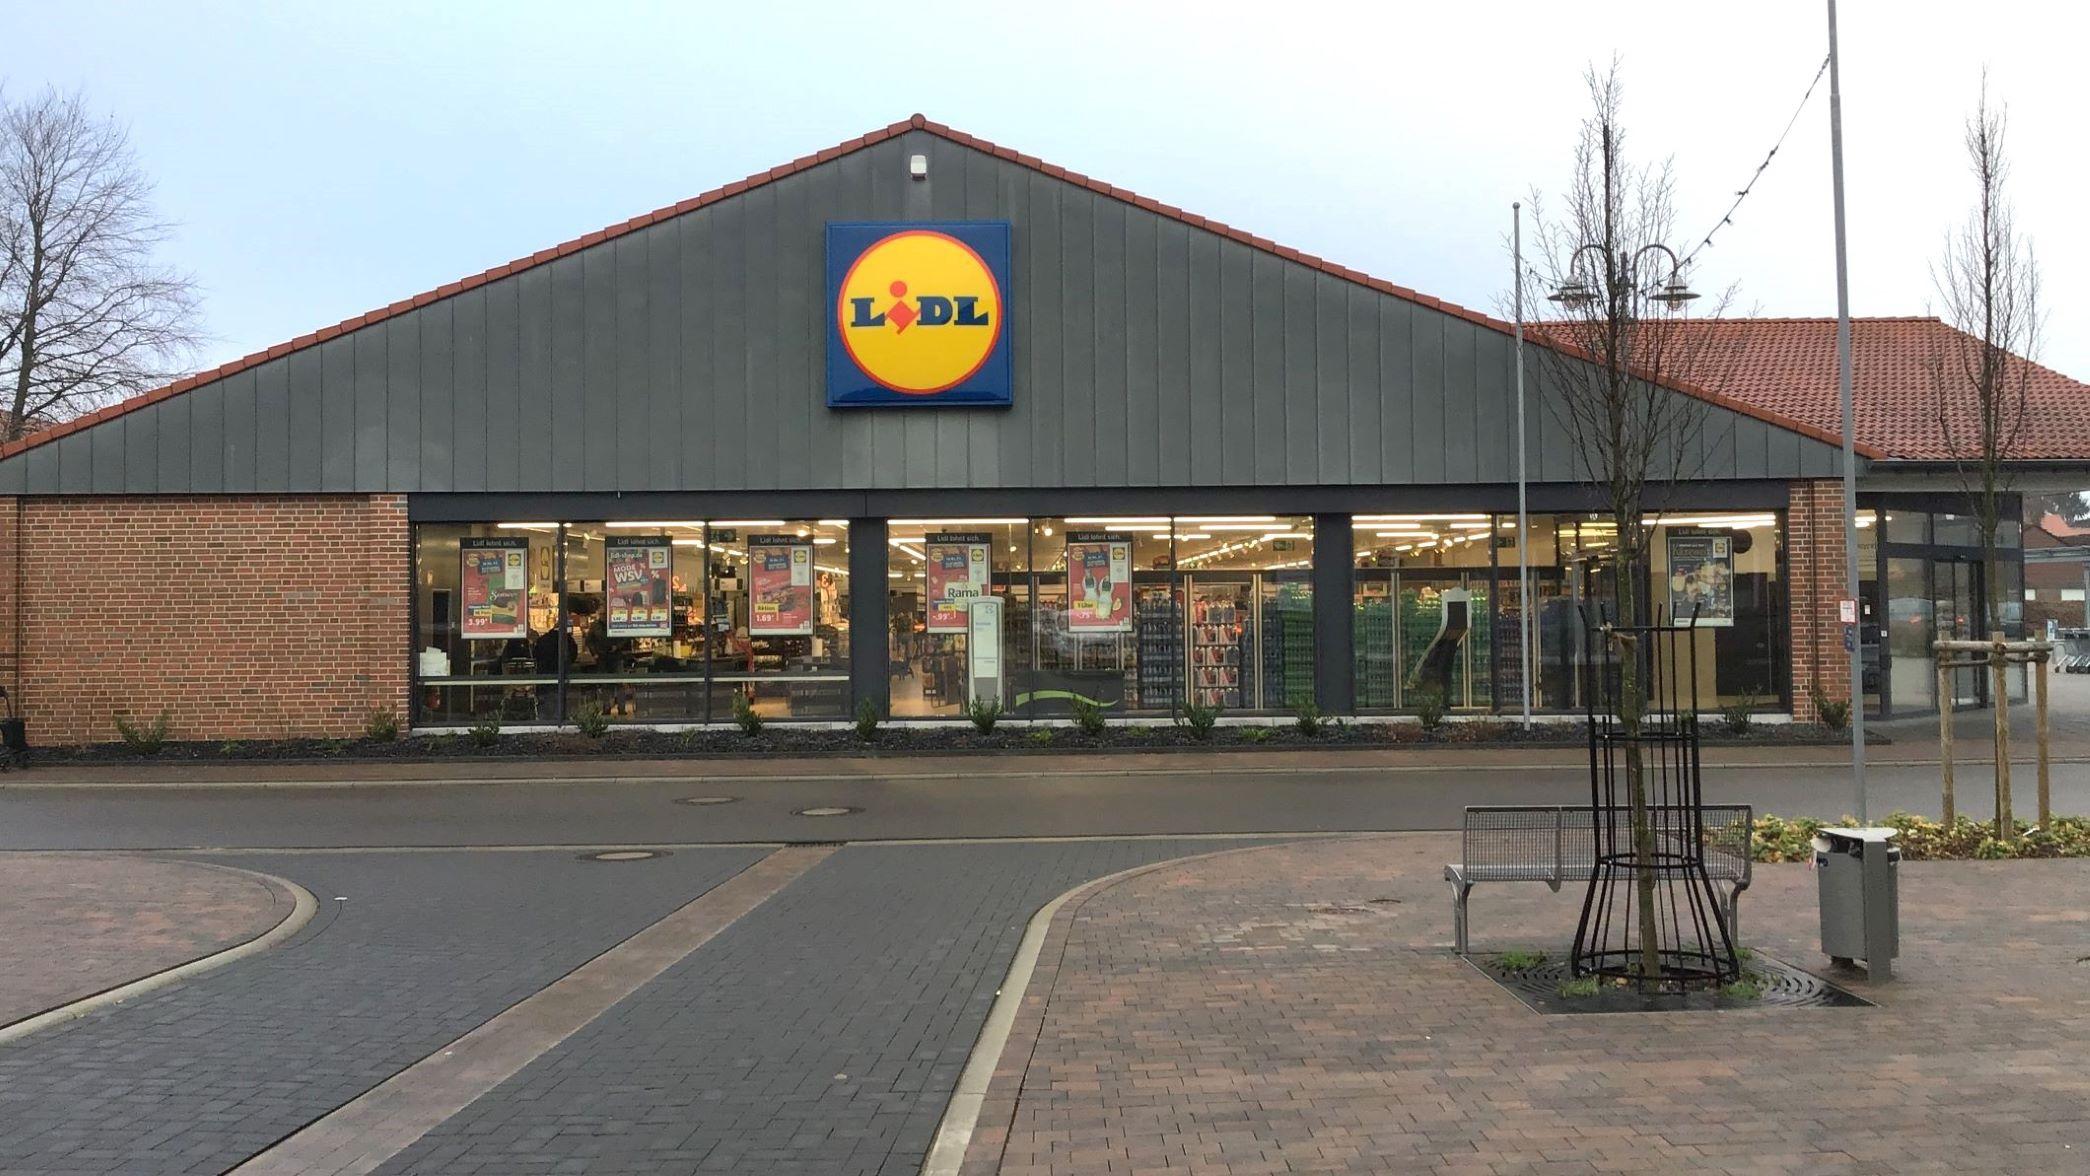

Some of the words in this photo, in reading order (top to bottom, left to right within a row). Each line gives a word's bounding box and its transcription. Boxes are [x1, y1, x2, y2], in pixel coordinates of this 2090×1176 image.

[613, 564, 636, 573] MODE
[614, 570, 643, 583] WSV
[948, 588, 979, 598] Rama
